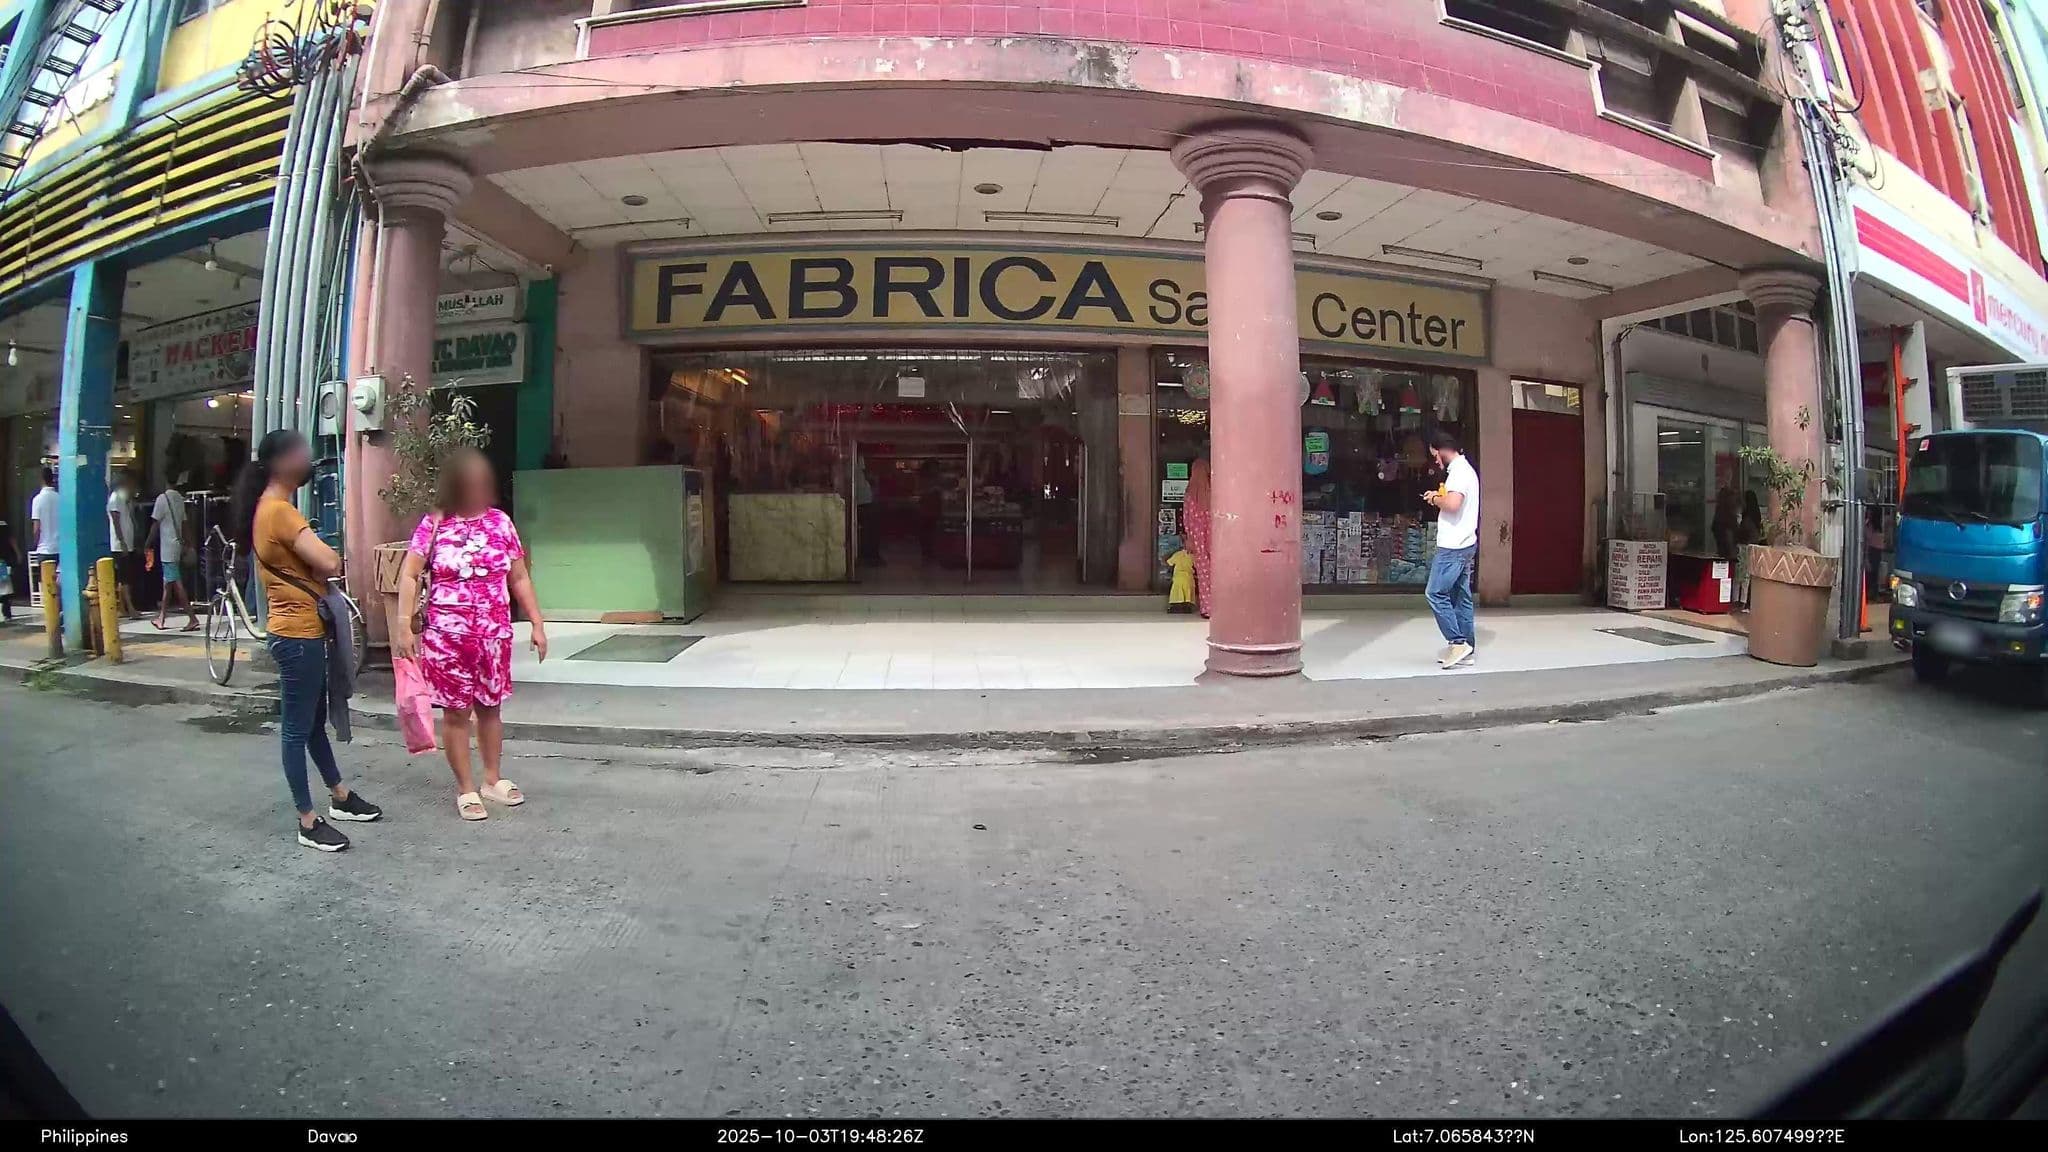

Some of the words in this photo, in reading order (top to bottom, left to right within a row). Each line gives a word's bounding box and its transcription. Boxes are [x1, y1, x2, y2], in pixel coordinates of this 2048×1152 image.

[656, 257, 1135, 323] FABRICA
[1149, 279, 1208, 327] Sa
[1312, 292, 1465, 350] Center
[1637, 555, 1663, 564] REPAIR
